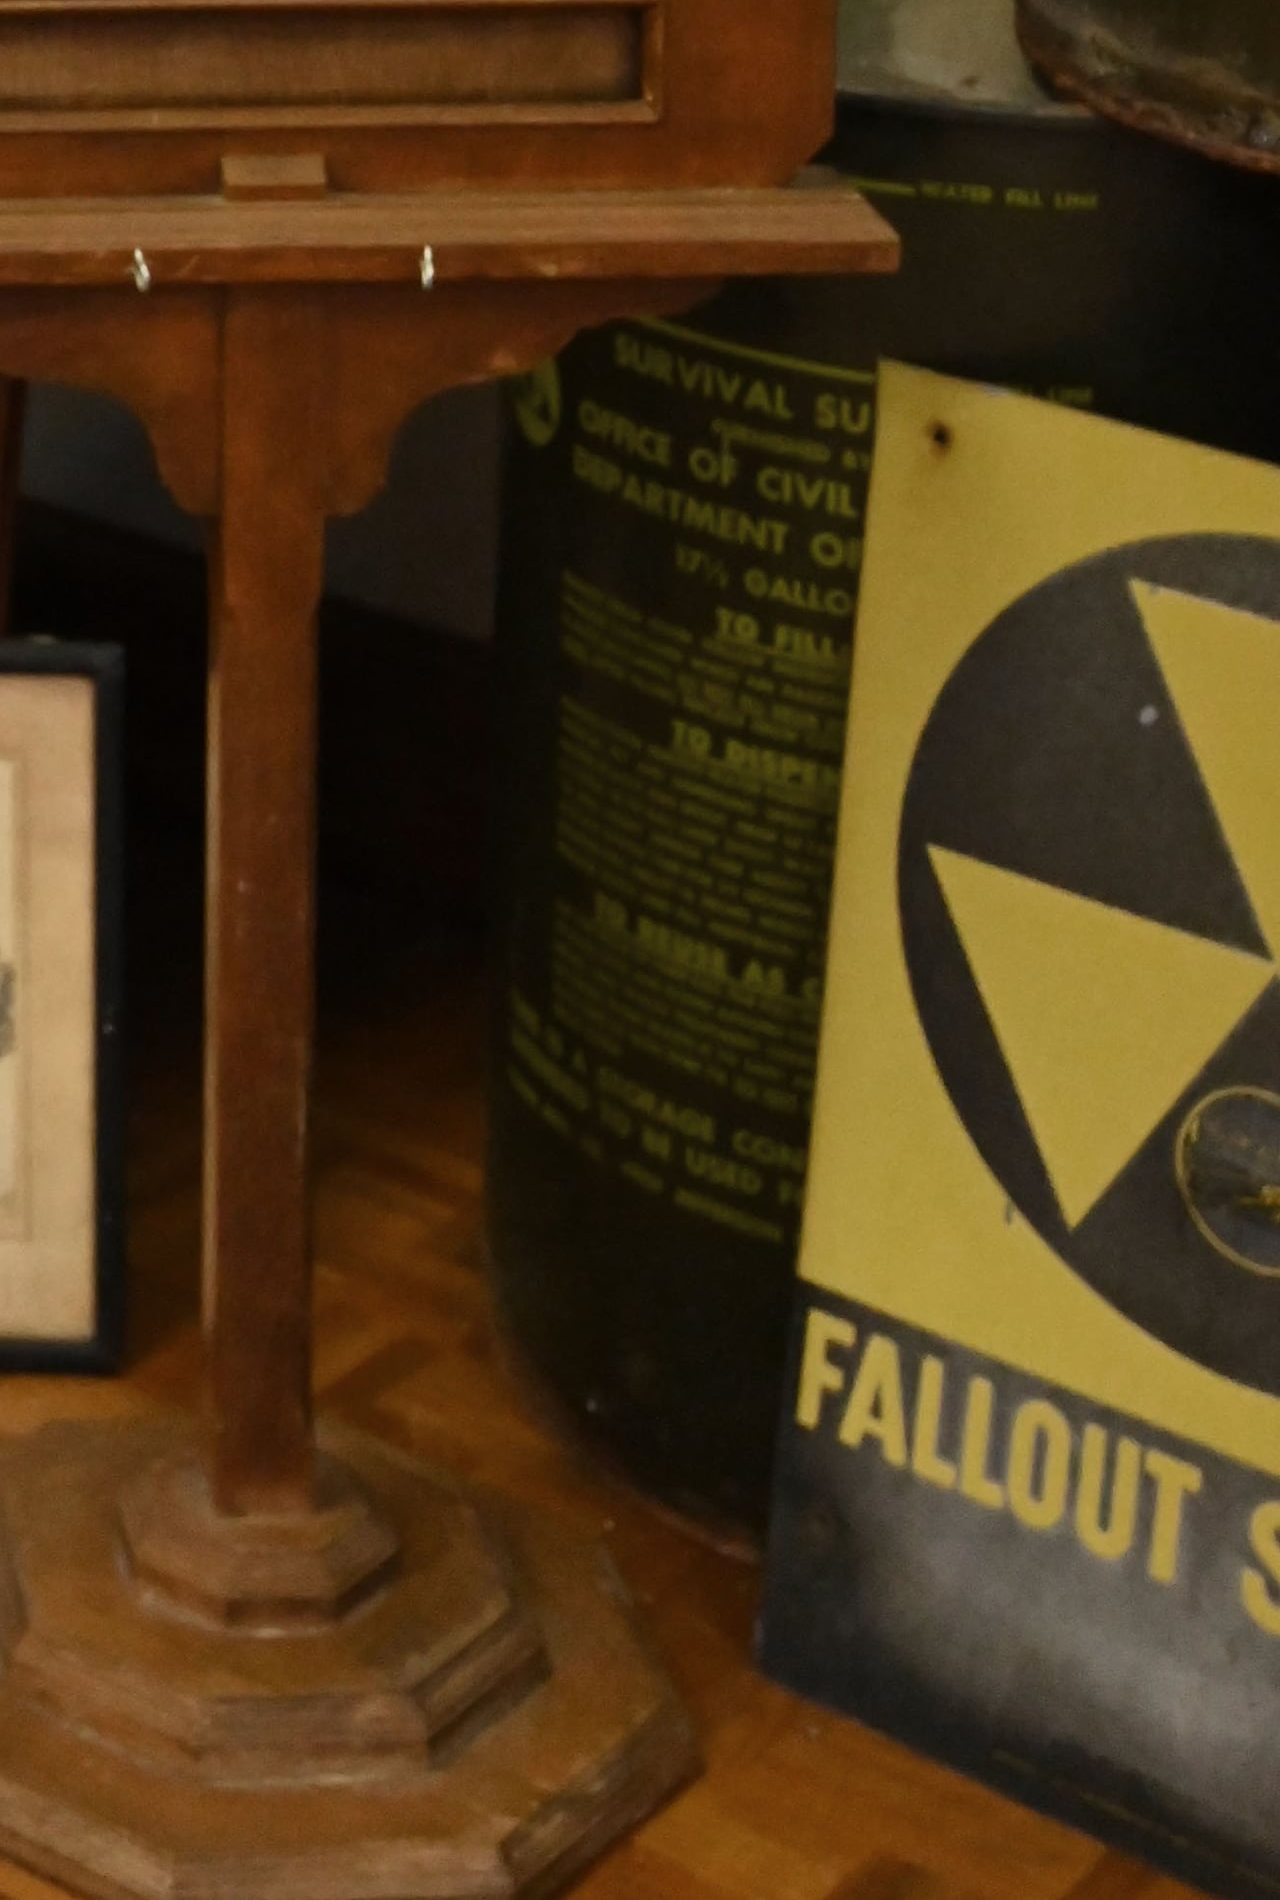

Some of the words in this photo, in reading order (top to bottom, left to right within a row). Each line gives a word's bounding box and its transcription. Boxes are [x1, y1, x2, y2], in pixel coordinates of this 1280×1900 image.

[613, 331, 795, 421] SURVIVAL
[572, 443, 790, 555] DEPARTMENT
[577, 400, 672, 468] OFFICE
[688, 445, 737, 488] OF
[756, 465, 858, 520] CIVIL
[794, 1306, 1204, 1586] FALLOUT
